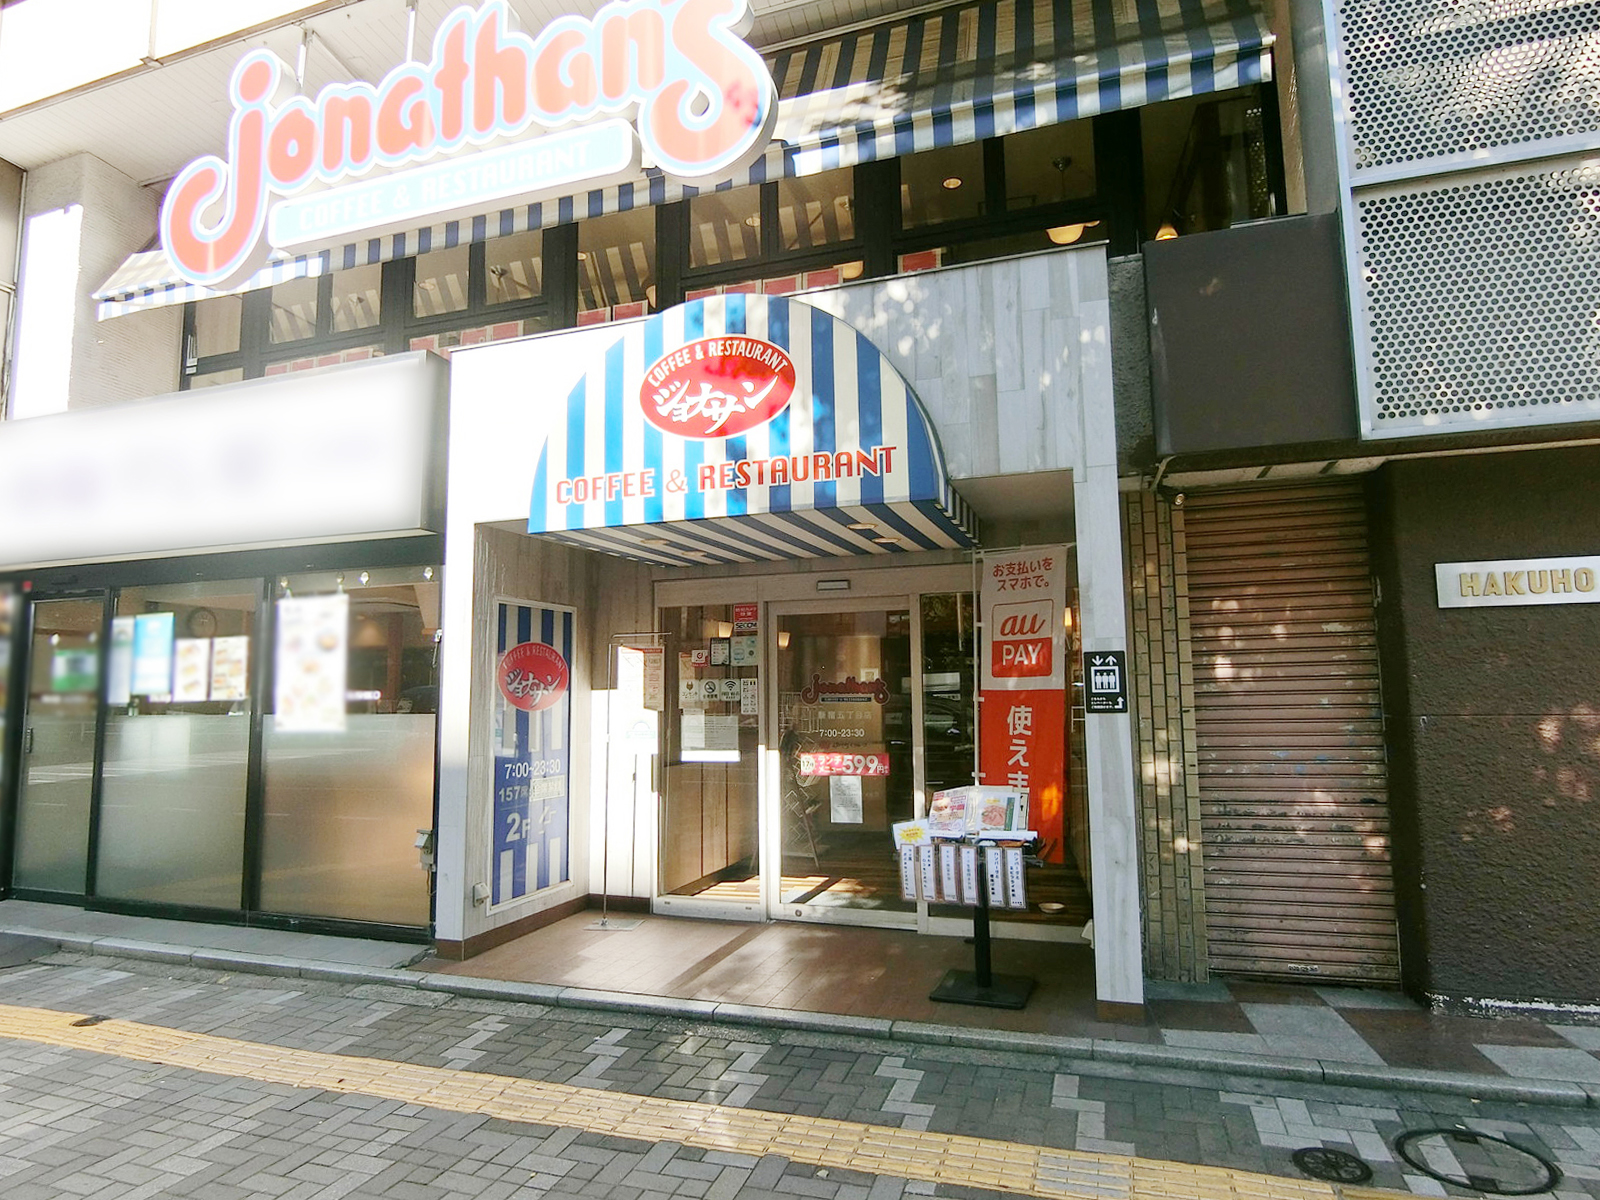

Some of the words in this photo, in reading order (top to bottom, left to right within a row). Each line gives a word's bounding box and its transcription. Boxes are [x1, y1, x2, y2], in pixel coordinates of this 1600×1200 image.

[301, 189, 386, 232] COFFEE
[421, 140, 593, 202] RESTAURANT
[647, 347, 692, 388] COFFEE
[695, 344, 705, 361] &
[708, 339, 789, 374] RESTAURANT
[652, 374, 779, 435] ジョナサン
[555, 469, 653, 505] COFFEE
[666, 468, 686, 493] &
[699, 446, 897, 490] RESTAURANT
[992, 557, 1054, 578] お支払いを
[997, 575, 1050, 592] スマホで。
[1459, 567, 1595, 597] HAKUHO
[1000, 613, 1046, 637] au
[1002, 642, 1043, 666] PAY
[504, 668, 562, 709] ジョナサン
